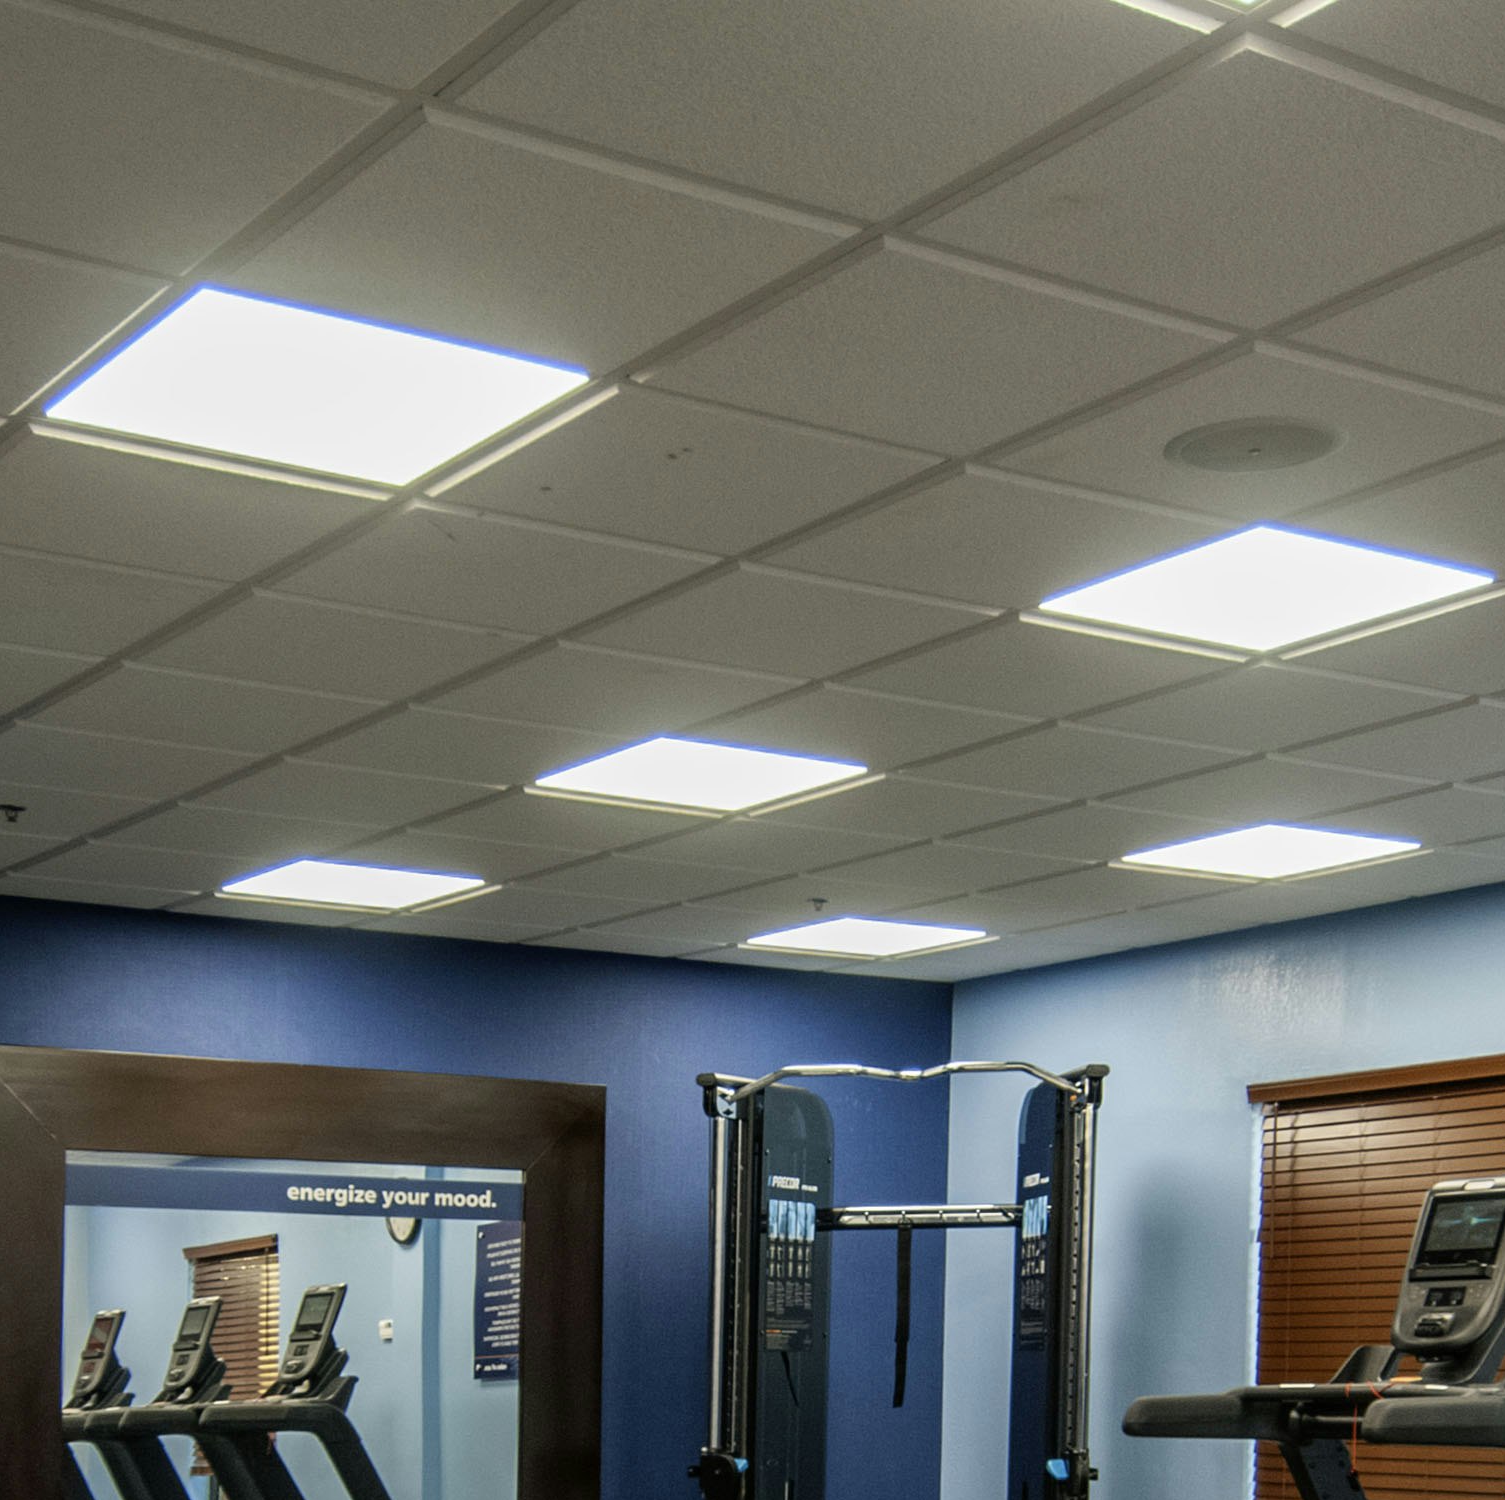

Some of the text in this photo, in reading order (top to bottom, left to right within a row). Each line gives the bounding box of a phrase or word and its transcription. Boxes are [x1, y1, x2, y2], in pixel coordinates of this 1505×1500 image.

[286, 1184, 497, 1208] energize your mood.
